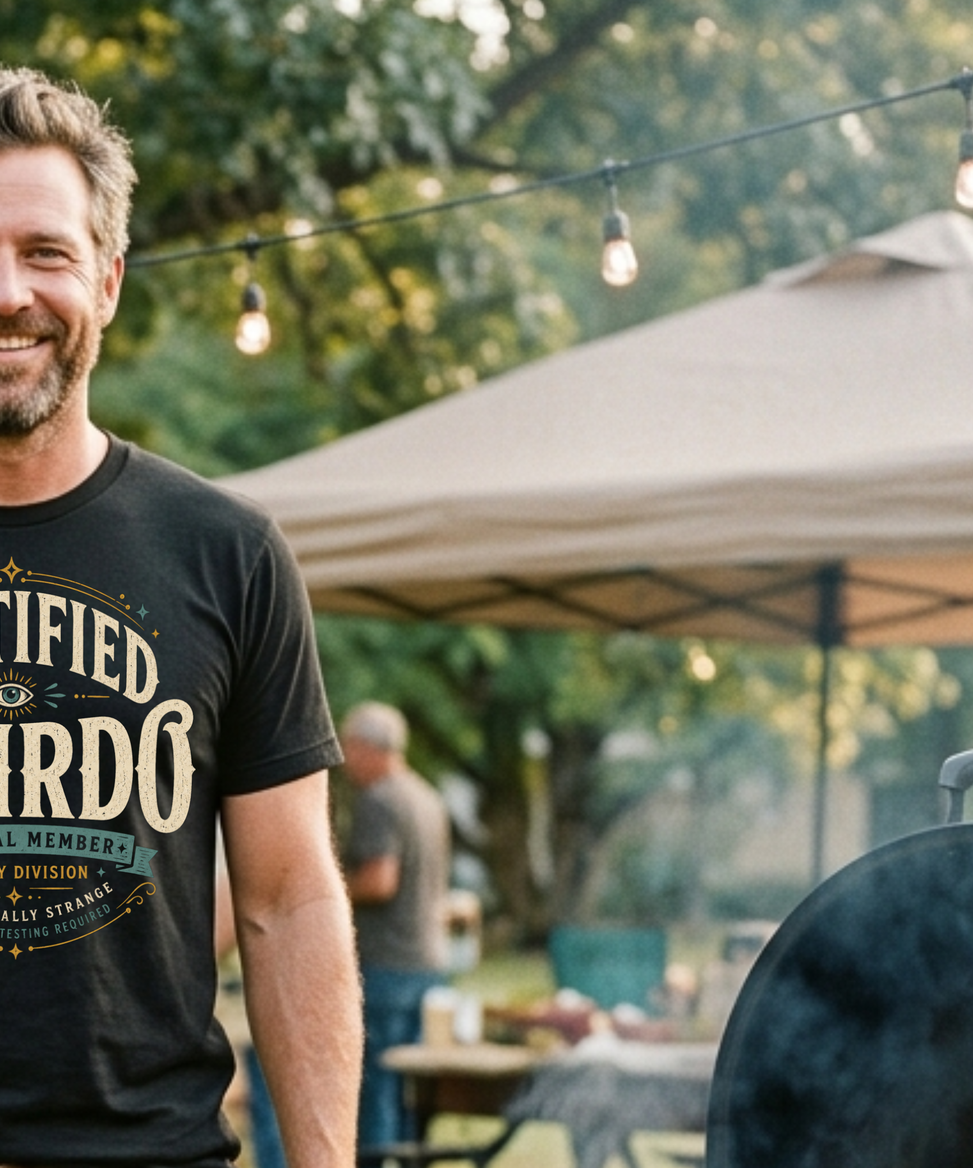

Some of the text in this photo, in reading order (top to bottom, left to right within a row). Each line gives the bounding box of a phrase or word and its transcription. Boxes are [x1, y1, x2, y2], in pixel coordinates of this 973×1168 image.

[27, 832, 114, 855] MEMBER
[14, 865, 88, 880] DIVISION
[45, 882, 114, 919] STRANGE
[0, 926, 49, 939] TESTING
[55, 903, 111, 934] REQUIRED
